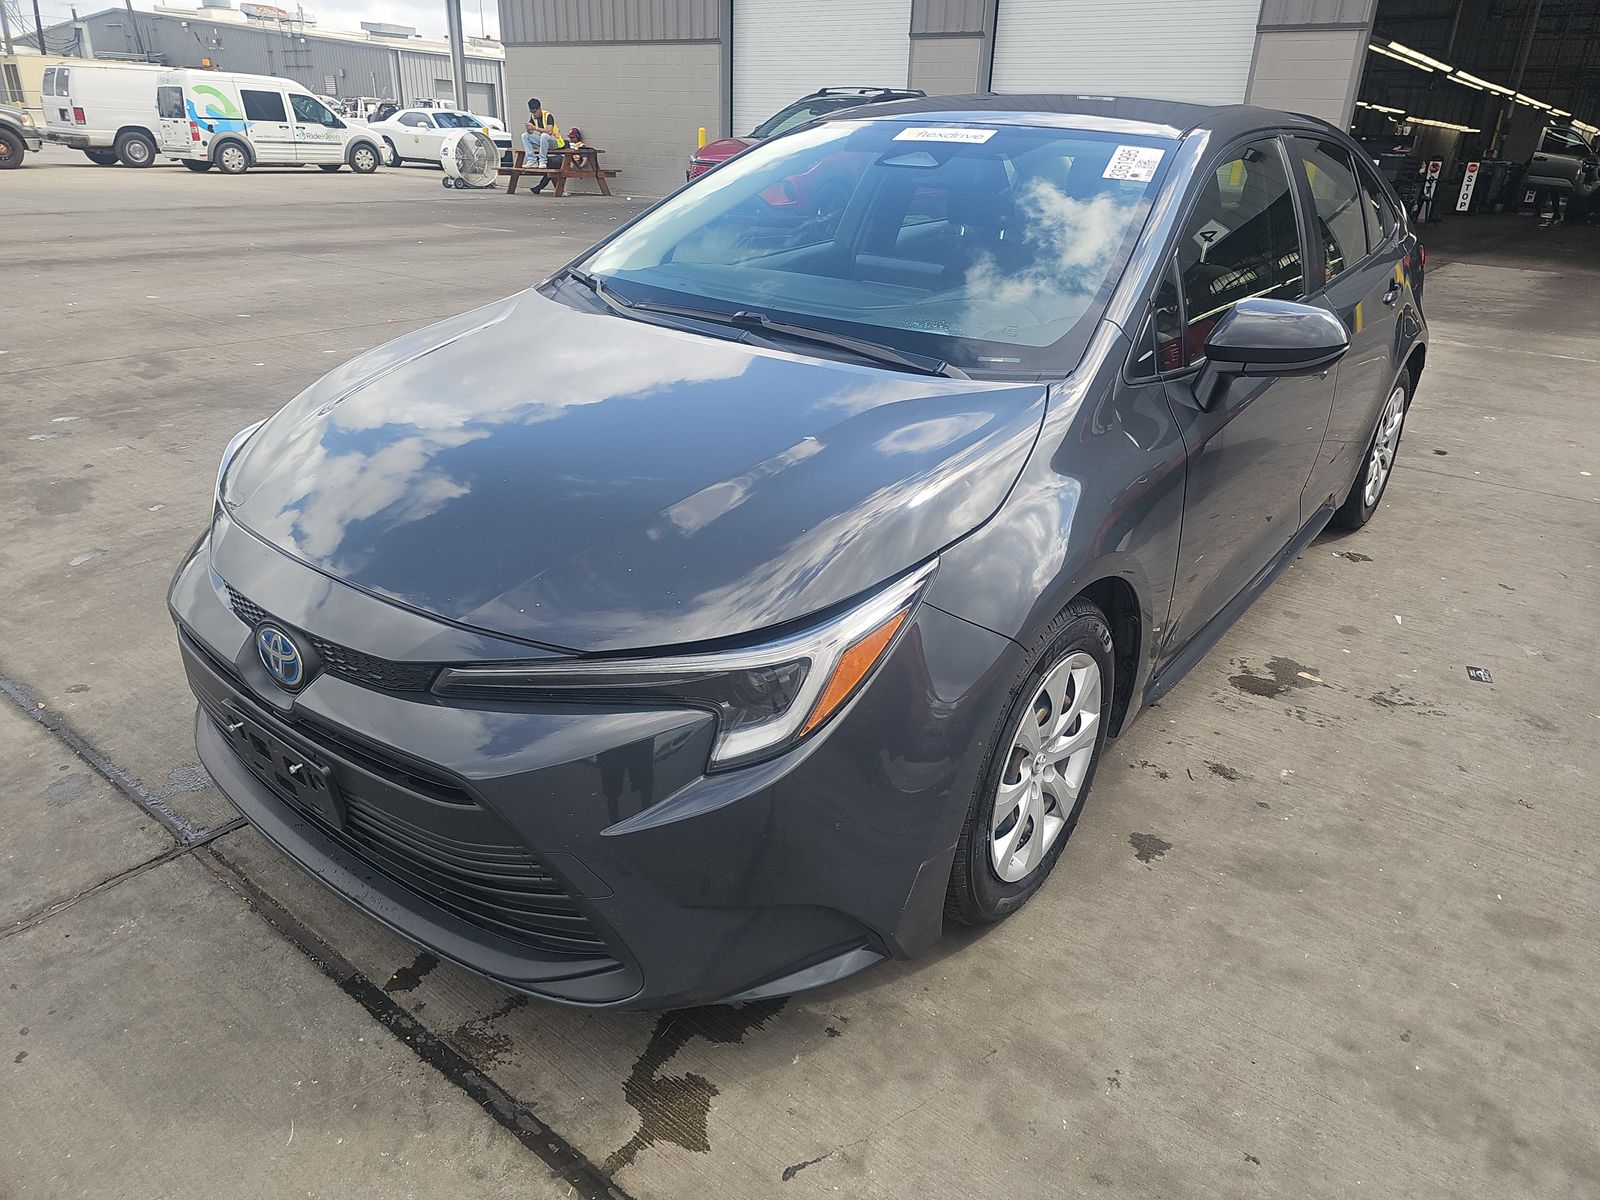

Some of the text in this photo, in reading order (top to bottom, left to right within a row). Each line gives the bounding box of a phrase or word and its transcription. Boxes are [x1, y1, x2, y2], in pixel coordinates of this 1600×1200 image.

[306, 131, 341, 141] RideKleen
[915, 130, 985, 141] flexdrive
[1460, 175, 1474, 209] STOP
